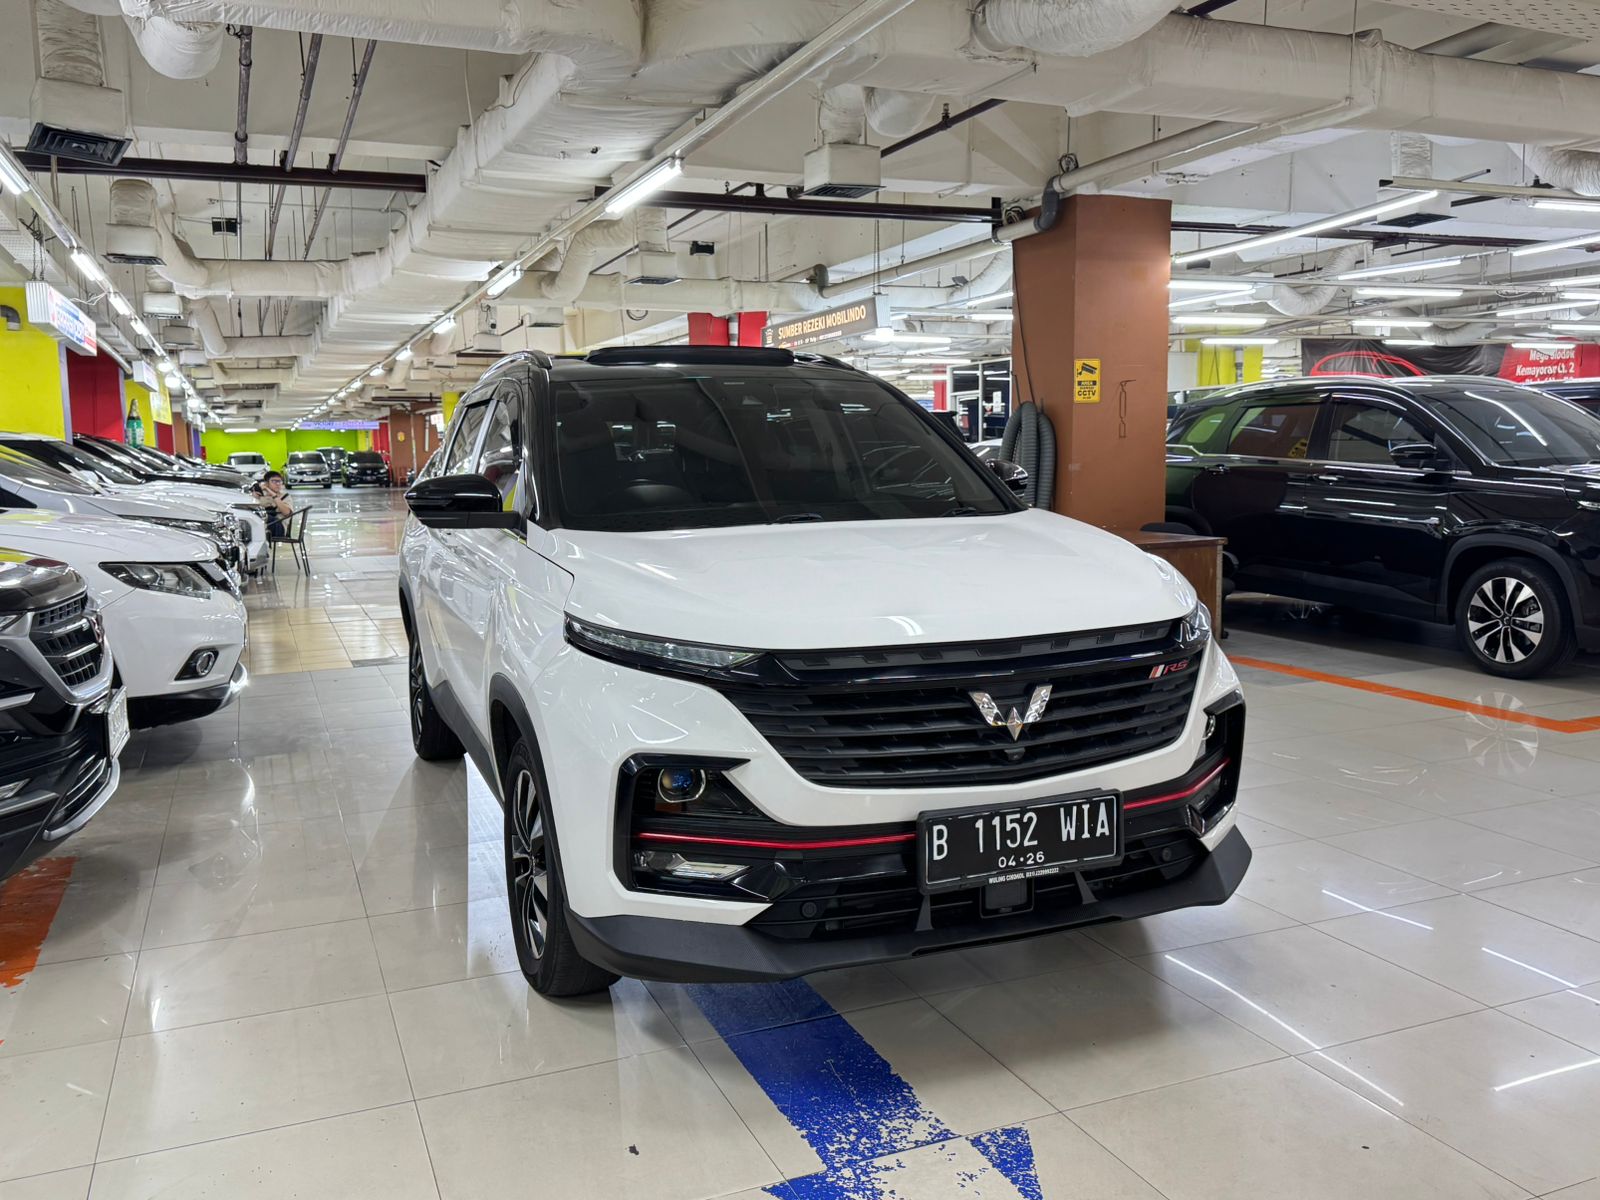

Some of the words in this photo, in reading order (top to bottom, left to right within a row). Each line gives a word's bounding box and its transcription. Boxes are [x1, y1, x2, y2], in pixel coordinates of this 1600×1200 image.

[778, 323, 803, 340] SUMBER
[803, 318, 826, 334] REZEKI
[826, 305, 866, 328] MOBILINDO
[1569, 362, 1575, 373] 2
[1163, 660, 1188, 675] RS
[932, 824, 948, 861] B
[975, 811, 1038, 854] 1152
[1059, 802, 1110, 842] WIA
